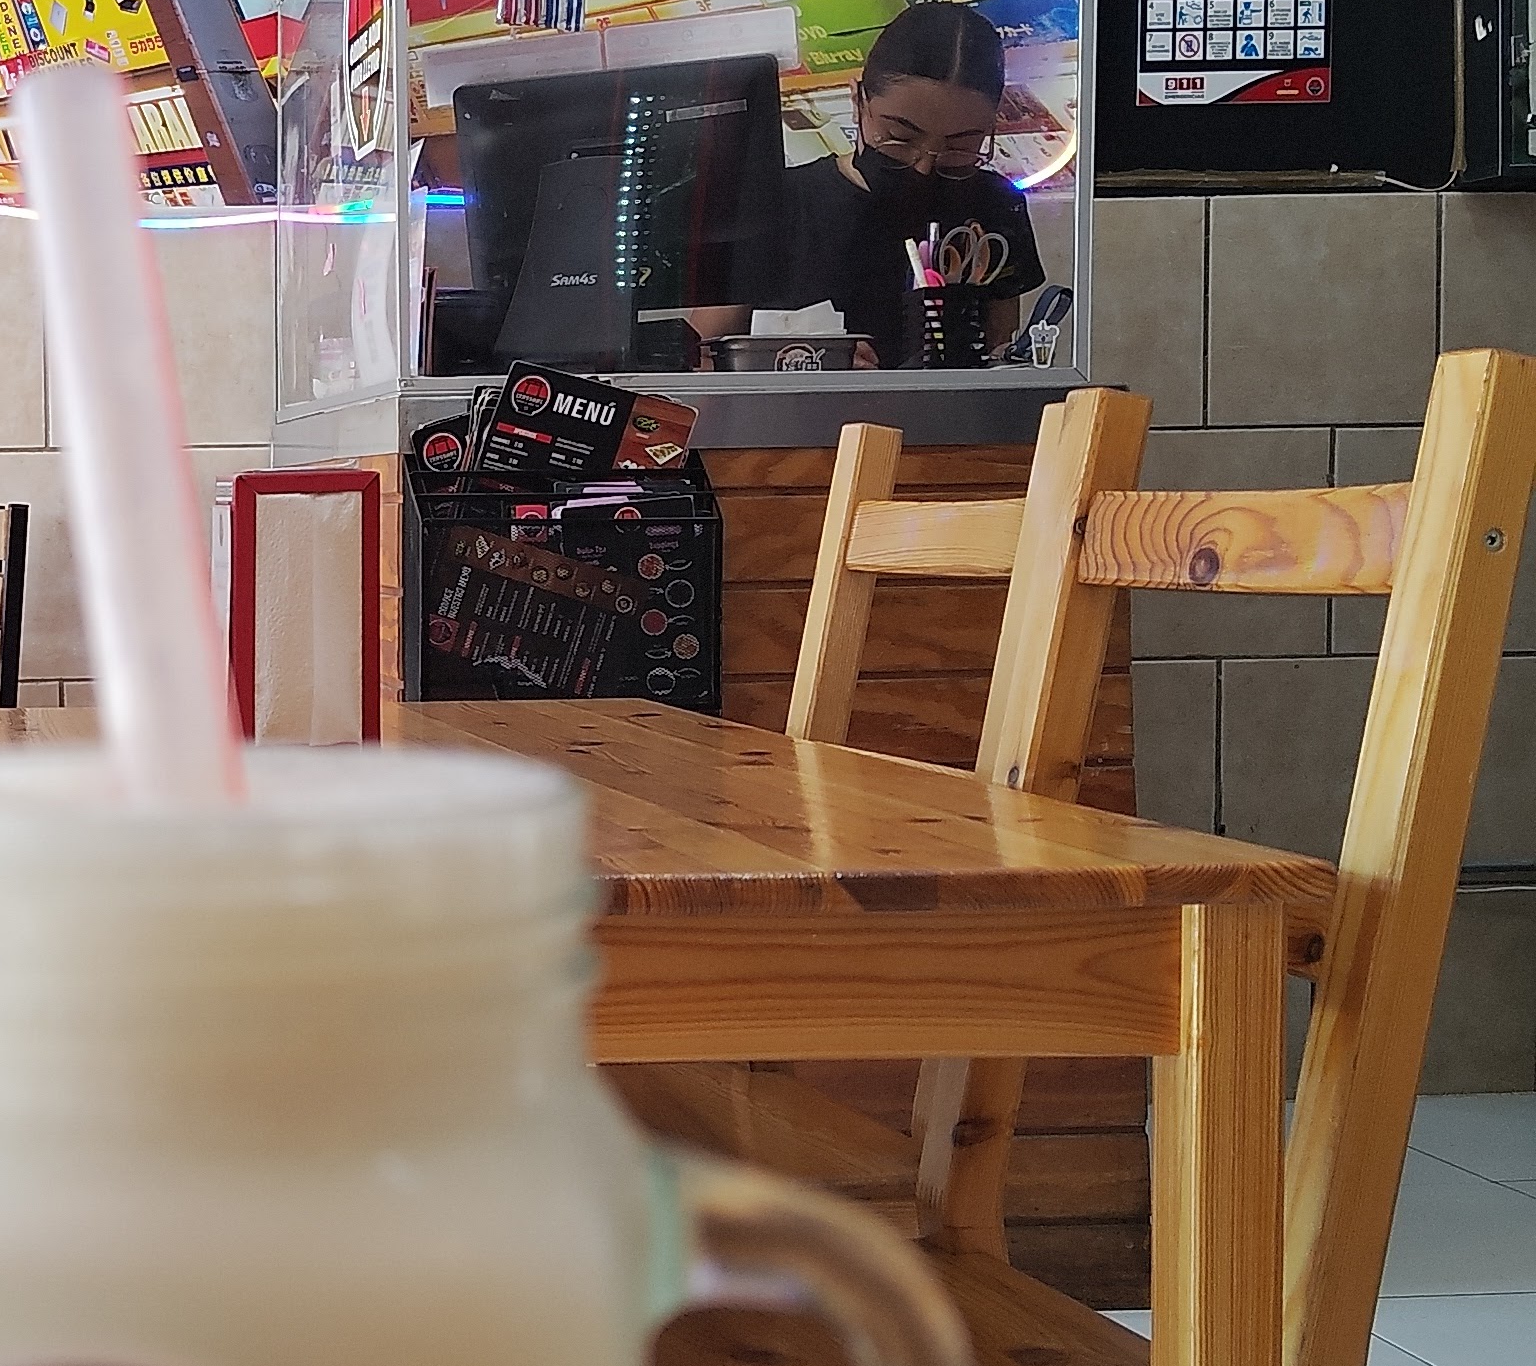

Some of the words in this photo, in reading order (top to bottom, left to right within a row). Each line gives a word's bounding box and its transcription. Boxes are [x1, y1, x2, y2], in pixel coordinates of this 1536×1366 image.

[695, 0, 713, 13] 3F
[28, 42, 80, 69] DISCOUNT
[1165, 77, 1205, 91] 911
[552, 392, 616, 427] MENÚ
